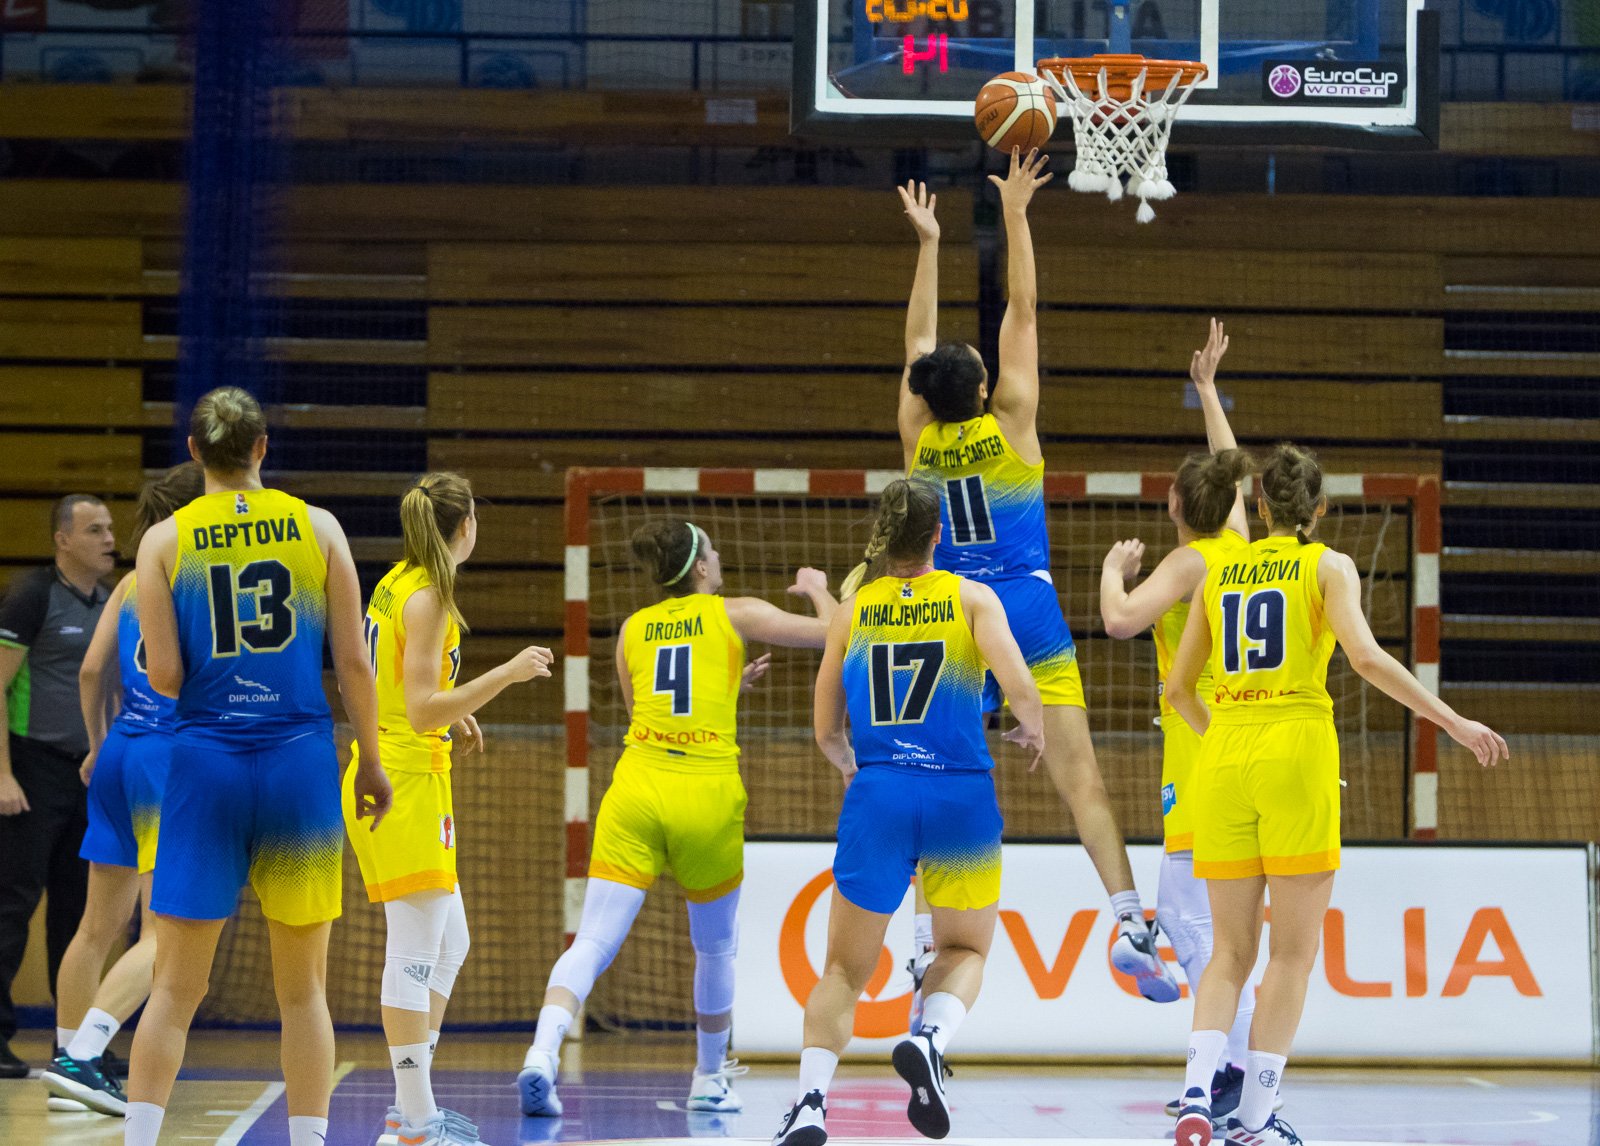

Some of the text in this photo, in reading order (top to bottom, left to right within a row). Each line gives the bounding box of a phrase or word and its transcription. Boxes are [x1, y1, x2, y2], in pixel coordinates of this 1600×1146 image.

[1304, 66, 1398, 84] EuroCup
[1307, 85, 1386, 95] women
[945, 474, 996, 546] 11
[193, 513, 302, 550] DEPTOVÁ
[208, 559, 297, 658] 13
[859, 595, 955, 627] MIHALJEVIČOVÁ
[1221, 588, 1287, 674] 19
[228, 693, 281, 703] DIPLOMAT
[652, 643, 692, 716] 4
[869, 640, 945, 726] 17
[653, 729, 719, 745] VEOLIA
[892, 752, 936, 760] DIPLOMAT
[999, 907, 1544, 1000] VELIA
